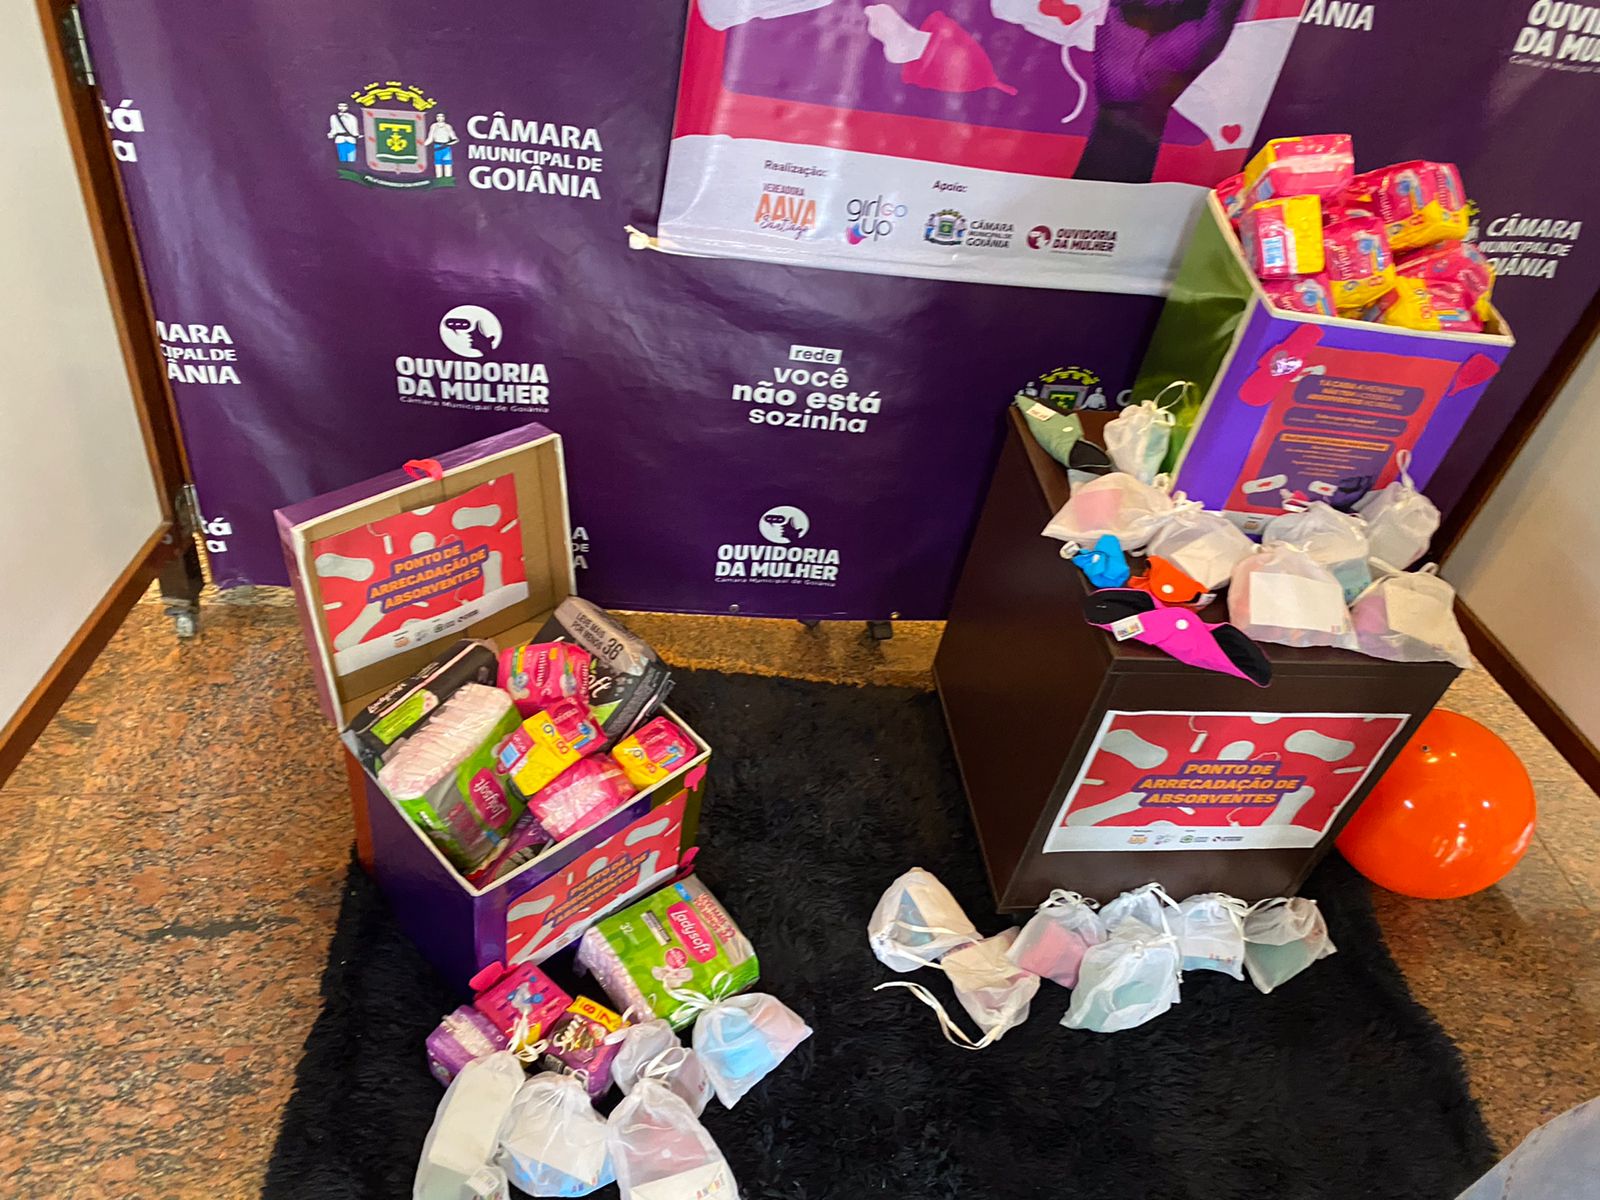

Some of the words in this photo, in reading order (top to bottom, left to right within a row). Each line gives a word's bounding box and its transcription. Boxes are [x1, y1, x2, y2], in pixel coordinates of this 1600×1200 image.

[1512, 27, 1558, 56] DA
[466, 111, 603, 152] CÂMARA
[112, 139, 138, 162] a
[467, 144, 575, 169] MUNICIPAL
[577, 156, 603, 172] DE
[763, 159, 829, 177] Realização:
[468, 165, 601, 200] GOIÂNIA
[754, 193, 816, 229] AAVA
[862, 218, 893, 241] up
[1057, 228, 1117, 241] OUVIDORIA
[1486, 213, 1582, 240] CÂMARA
[1053, 239, 1067, 248] DA
[1070, 240, 1115, 252] MULHER
[1479, 241, 1549, 253] MUNICIPAL
[1547, 243, 1574, 256] DE
[209, 349, 238, 361] DE
[795, 348, 836, 362] rede
[395, 356, 550, 384] OUVIDORIA
[773, 367, 849, 389] você
[397, 376, 436, 398] DA
[440, 381, 550, 405] MULHER
[731, 381, 797, 406] não
[806, 391, 882, 414] está
[749, 409, 867, 433] sozinha
[572, 527, 589, 540] A
[206, 540, 228, 553] a
[717, 544, 840, 565] OUVIDORIA
[394, 551, 442, 574] PONTO
[443, 544, 461, 558] DE
[574, 555, 589, 569] A
[370, 557, 469, 598] ARRECADAÇÃO
[469, 548, 486, 564] DE
[715, 561, 746, 577] DA
[750, 561, 839, 581] MULHER
[385, 566, 481, 609] ABSORVENTES
[1183, 764, 1248, 775] PONTO
[1248, 765, 1275, 775] DE
[1139, 777, 1273, 792] ARRECADAÇÃO
[1274, 779, 1300, 790] DE
[1146, 793, 1278, 804] ABSORVENTES
[670, 910, 711, 954] Ladysoft
[582, 1003, 596, 1014] 8
[600, 1012, 611, 1023] 7
